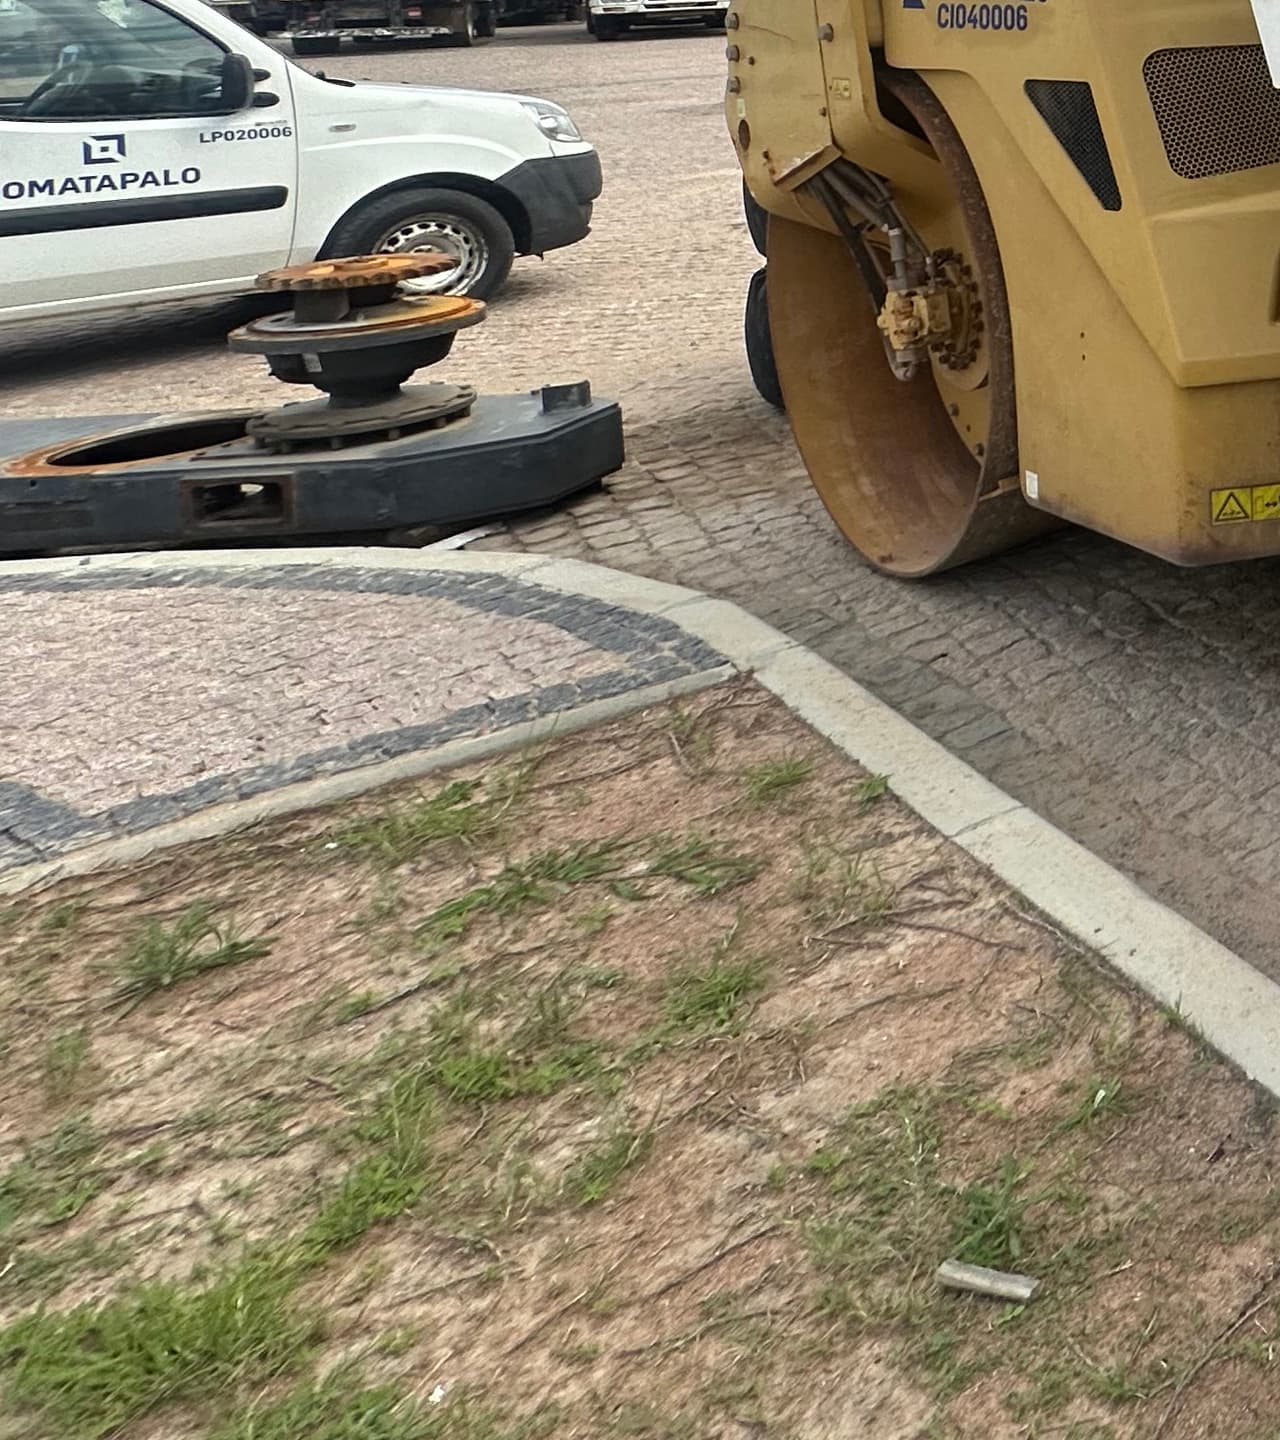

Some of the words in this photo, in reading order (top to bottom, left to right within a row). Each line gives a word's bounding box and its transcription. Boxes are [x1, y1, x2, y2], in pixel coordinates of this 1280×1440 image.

[936, 3, 1029, 31] CI040006
[199, 126, 293, 144] LP020006
[2, 166, 202, 200] OMATAPALO
